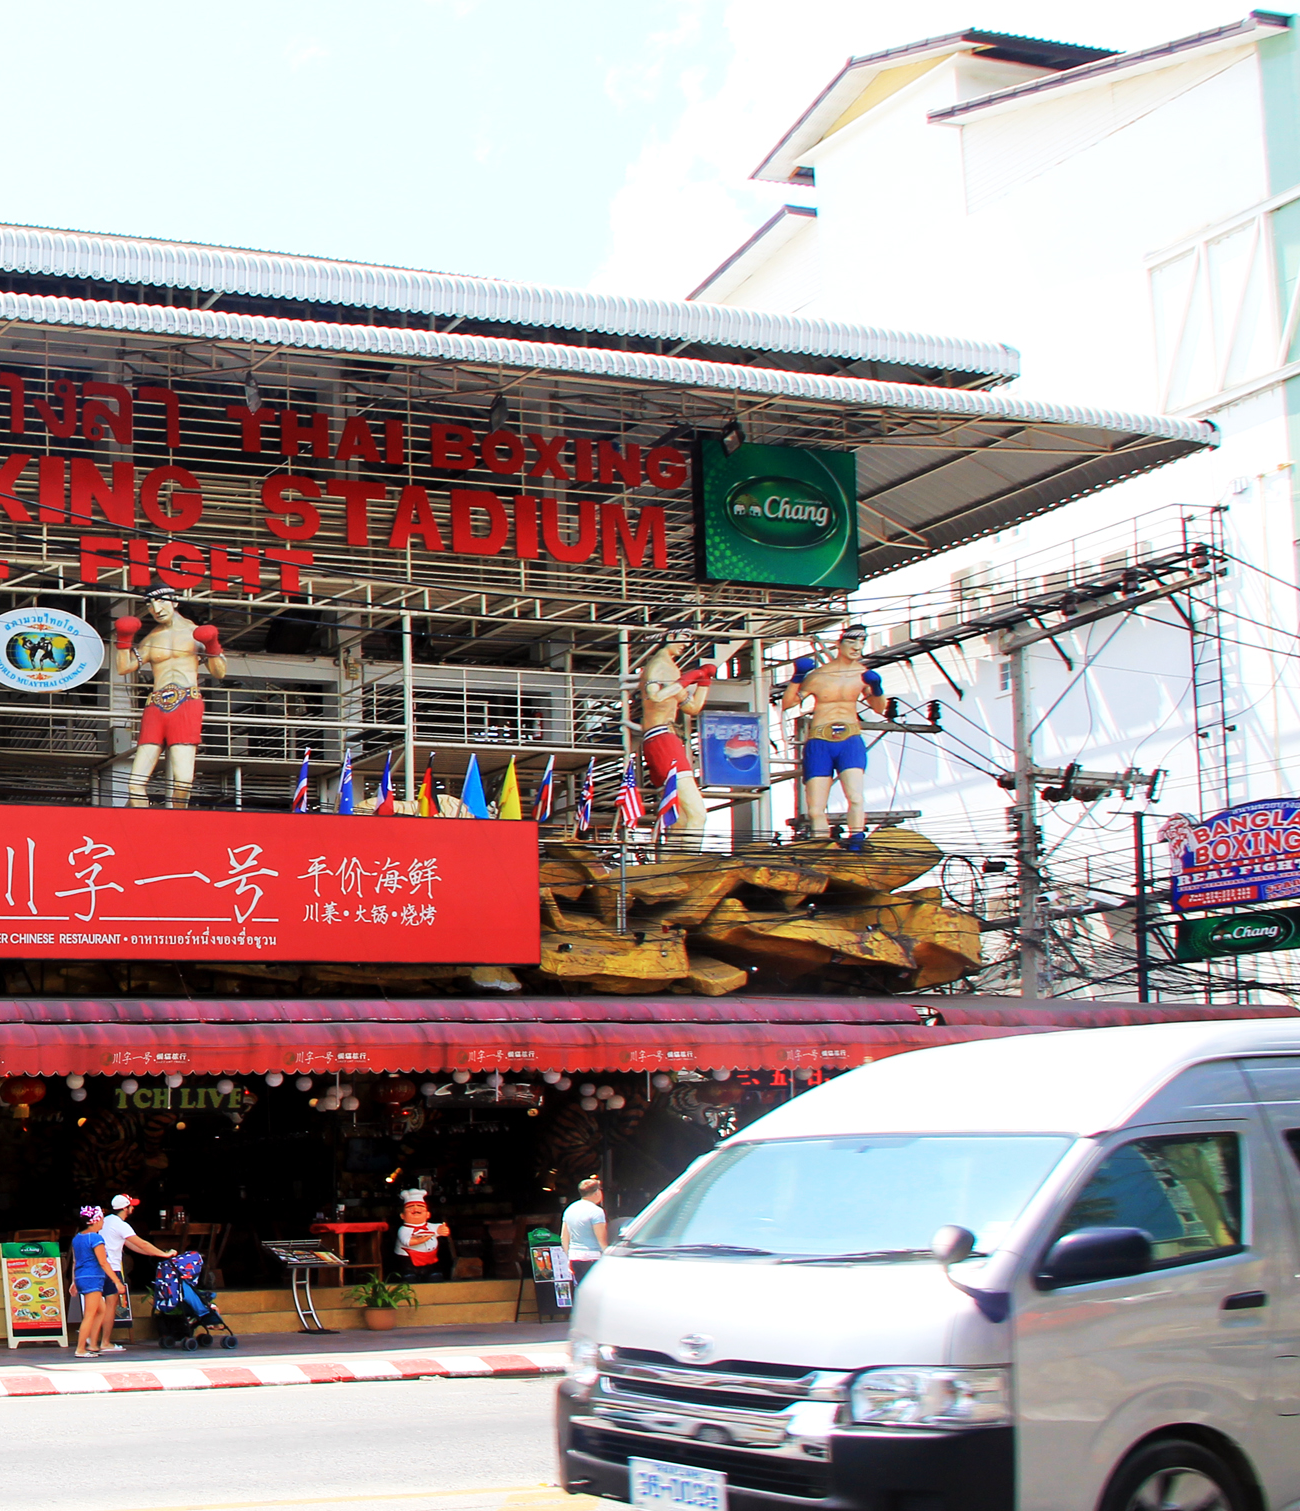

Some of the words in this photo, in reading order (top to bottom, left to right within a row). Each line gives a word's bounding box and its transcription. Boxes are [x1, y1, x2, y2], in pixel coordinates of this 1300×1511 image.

[226, 405, 404, 465] THAI
[430, 422, 688, 491] BOXING
[260, 474, 667, 569] STADIUM
[763, 495, 829, 527] Chang
[80, 535, 315, 596] FIGHT
[15, 675, 58, 688] MUAYTHAI
[58, 661, 88, 685] COUNCIL
[701, 723, 758, 741] PEPSI
[1209, 855, 1286, 870] STADIUM
[297, 855, 442, 899] 平价海鲜
[1177, 868, 1236, 887] REAL
[10, 933, 55, 944] CHINESE
[59, 933, 121, 945] RESTAURANT
[1232, 925, 1279, 938] Chang
[115, 1088, 171, 1109] TCH
[180, 1088, 241, 1109] LIVE
